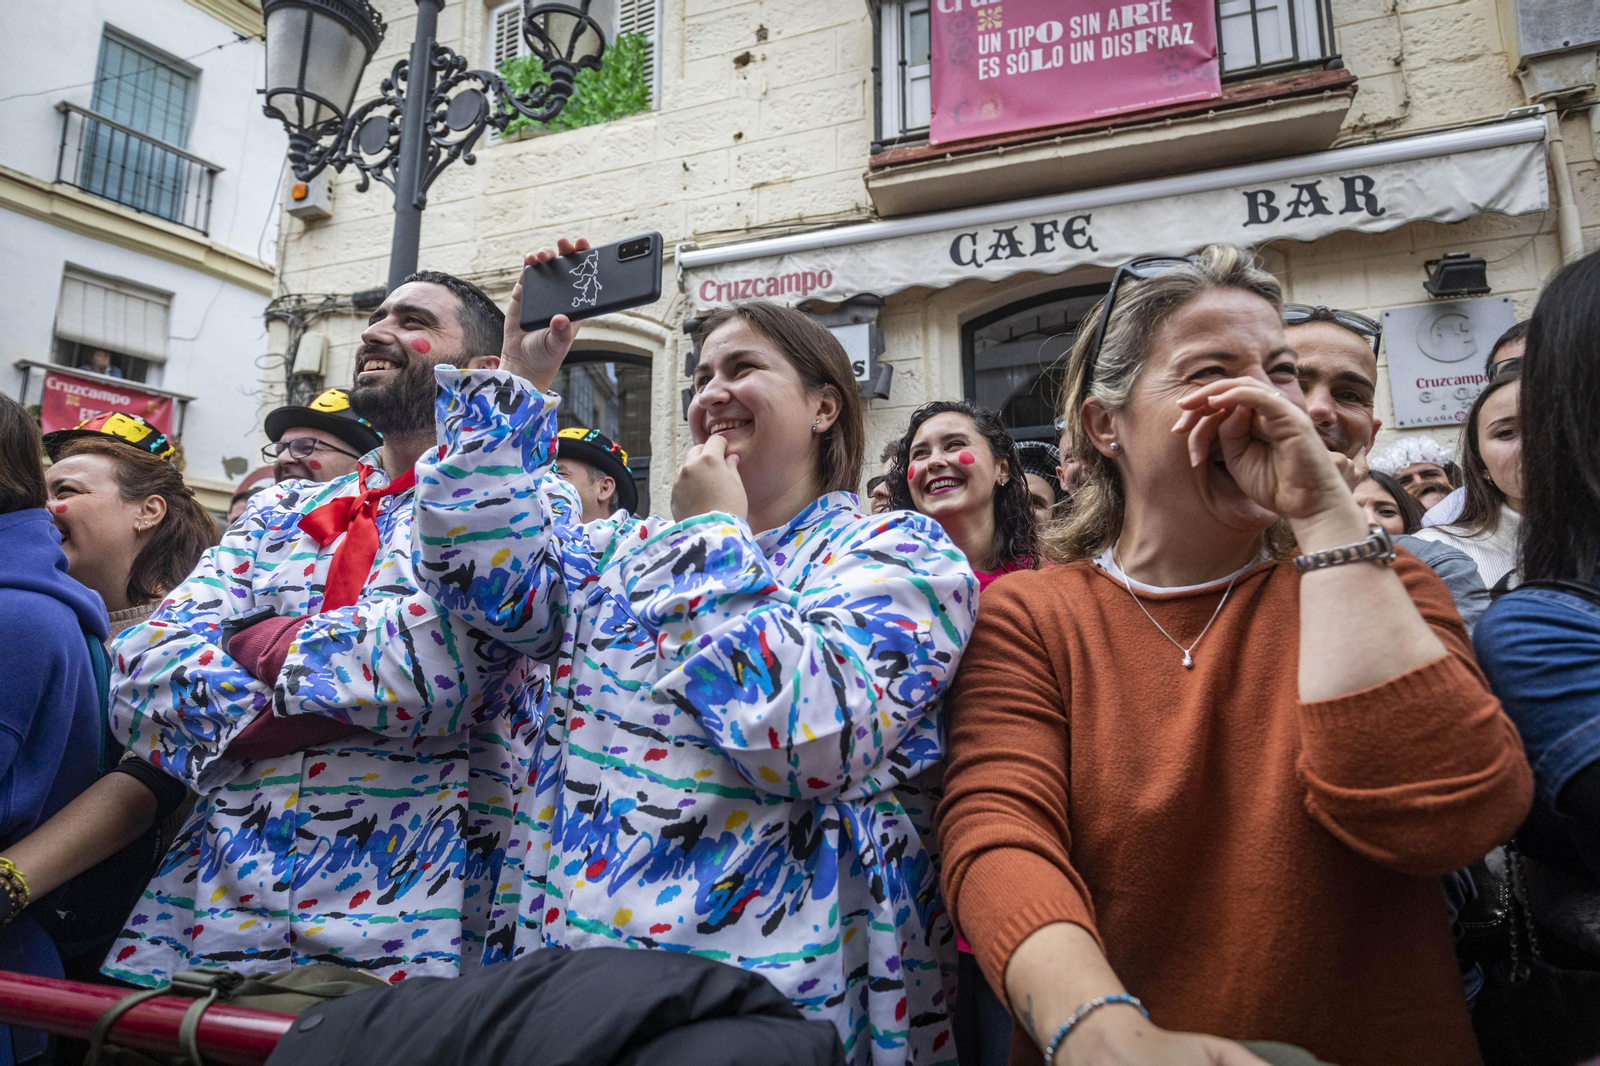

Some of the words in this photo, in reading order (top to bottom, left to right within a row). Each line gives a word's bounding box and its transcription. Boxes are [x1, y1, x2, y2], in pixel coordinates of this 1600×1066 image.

[978, 57, 1000, 80] ES
[1006, 45, 1064, 75] SÓLO
[1070, 40, 1095, 64] UN
[1102, 22, 1195, 59] DISFRAZ
[979, 32, 1001, 55] UN
[1007, 20, 1063, 50] TIPO
[1070, 12, 1101, 38] SIN
[1107, 0, 1173, 32] ARTE
[949, 214, 1098, 269] CAFE
[1242, 175, 1386, 228] BAR
[699, 268, 833, 302] Cruzcampo
[46, 377, 131, 406] Cruzcampo
